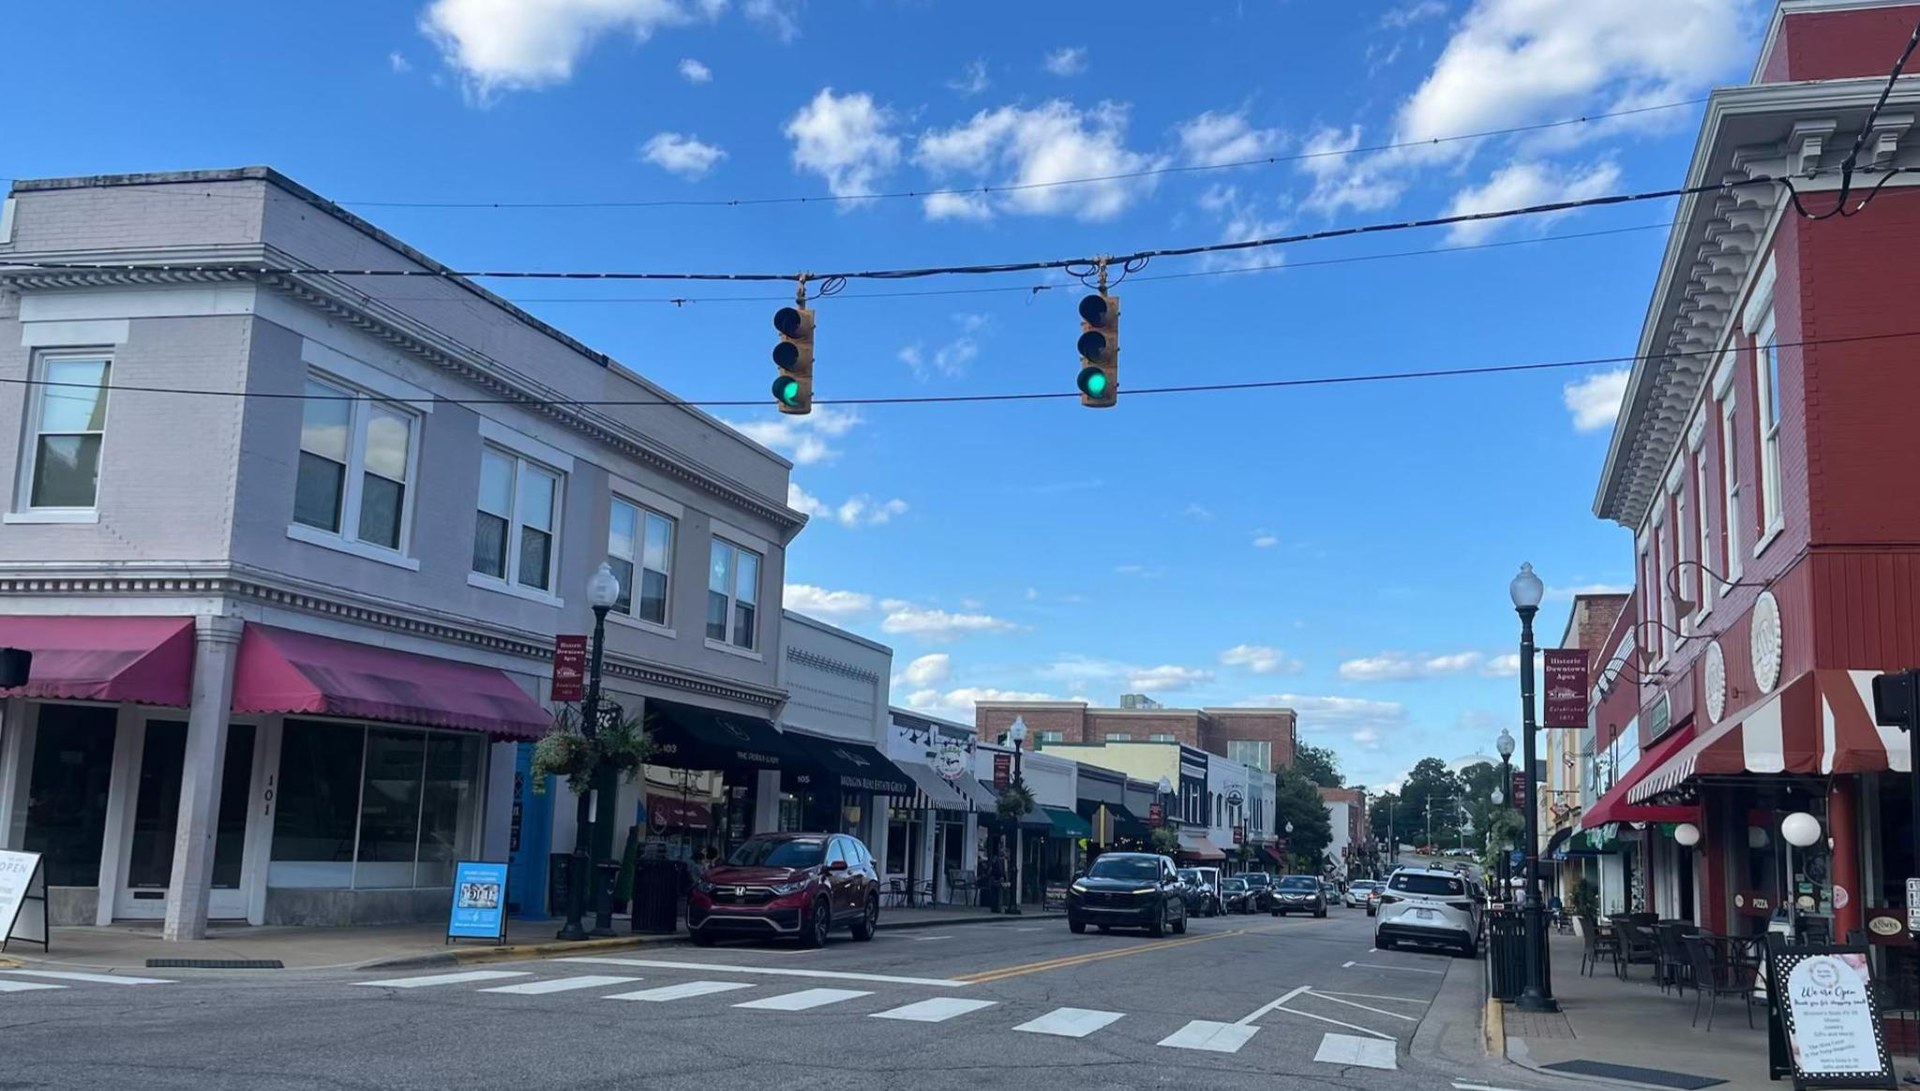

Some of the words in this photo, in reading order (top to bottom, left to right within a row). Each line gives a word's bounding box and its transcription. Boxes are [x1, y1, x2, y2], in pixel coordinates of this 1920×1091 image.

[797, 775, 810, 783] 105
[264, 773, 273, 816] 101
[0, 862, 28, 873] OPEN
[1753, 898, 1768, 909] PIZZA
[1801, 986, 1818, 997] We
[1835, 986, 1856, 999] Open
